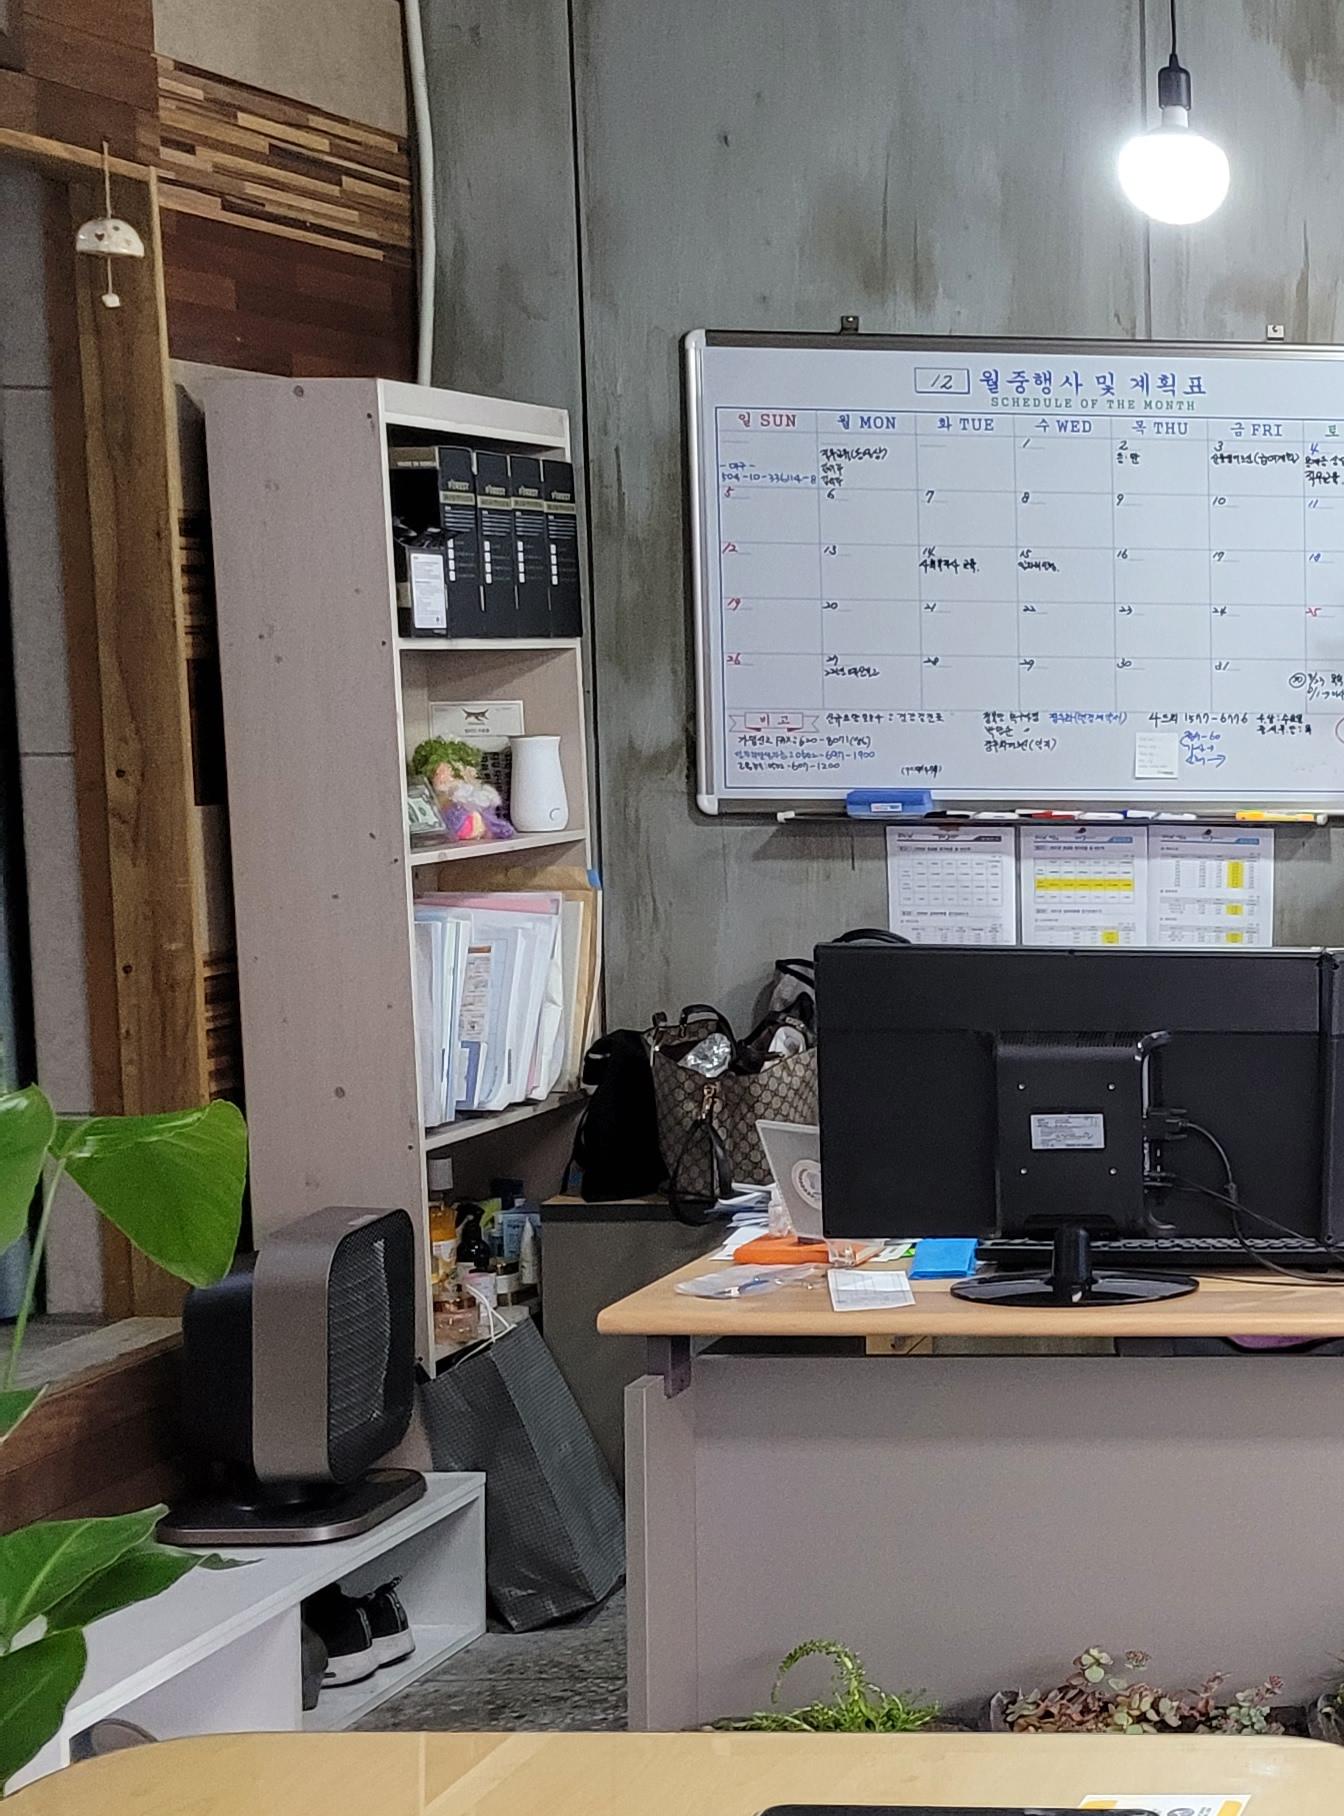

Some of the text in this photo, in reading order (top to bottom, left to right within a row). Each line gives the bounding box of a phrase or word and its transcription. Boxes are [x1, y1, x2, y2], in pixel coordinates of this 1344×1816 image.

[930, 374, 953, 391] 12
[979, 368, 1207, 398] 월중행사 및 계획표
[991, 396, 1196, 412] SCHEDULE OF THE MONTH
[738, 413, 751, 429] 일
[760, 414, 797, 429] SUN
[837, 415, 851, 430] 월
[859, 416, 897, 431] MON
[937, 416, 953, 431] 화
[959, 418, 995, 432] TUE
[1035, 418, 1050, 433] 수
[1056, 420, 1092, 434] WED
[1132, 420, 1147, 435] 목
[1153, 422, 1189, 436] THU
[1230, 423, 1245, 436] 금
[1251, 424, 1283, 437] FRI
[1325, 425, 1340, 438] 토
[1118, 440, 1129, 451] 2
[1213, 440, 1224, 452] 3
[1310, 442, 1320, 455] 4
[724, 487, 1320, 509] 5 6 7 8 9 10 11
[722, 542, 1320, 563] 12 13 14 15 16 17 18
[727, 597, 1322, 617] 19 20 21 22 23 24 25
[726, 653, 1229, 671] 26 27 28 29 30 31
